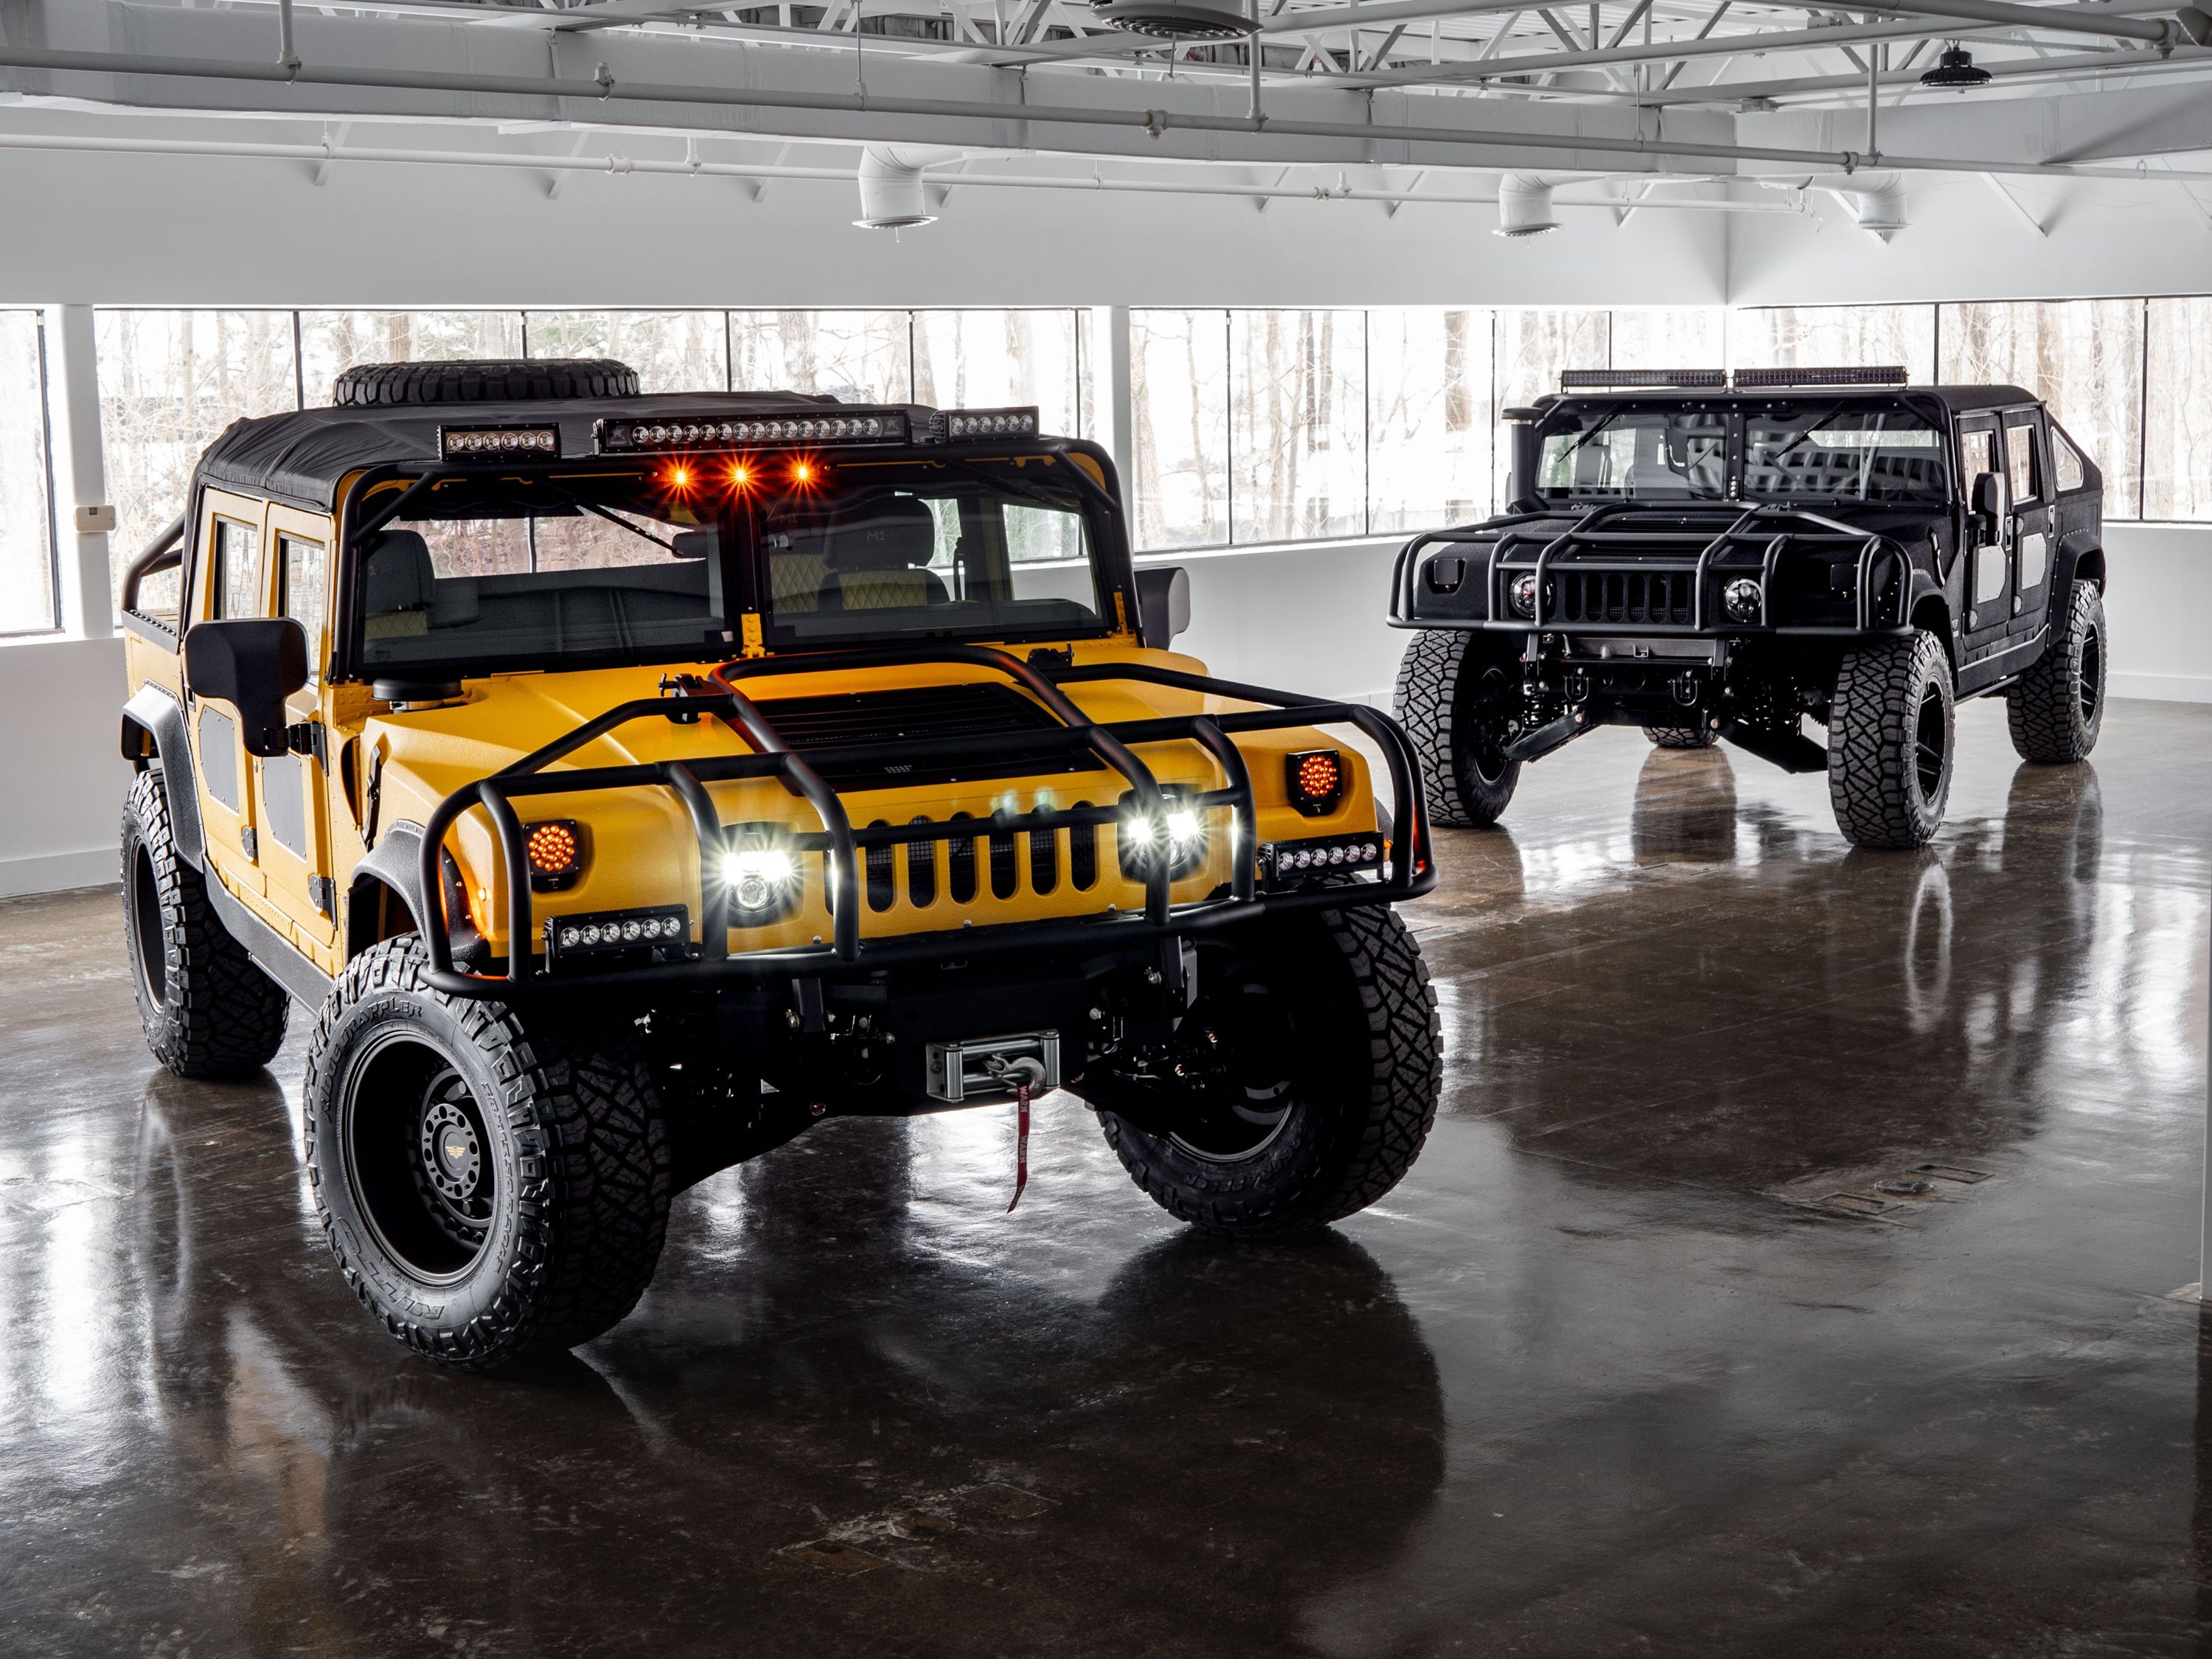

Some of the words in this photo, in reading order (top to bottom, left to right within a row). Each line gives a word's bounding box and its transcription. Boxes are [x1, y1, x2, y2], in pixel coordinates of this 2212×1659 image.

[866, 530, 886, 541] M1
[321, 1043, 341, 1123] RIDGE
[340, 996, 423, 1048] GRAPPLER
[1019, 1085, 1028, 1113] WARN
[1019, 1135, 1028, 1164] WARN
[337, 1217, 445, 1321] NITTO
